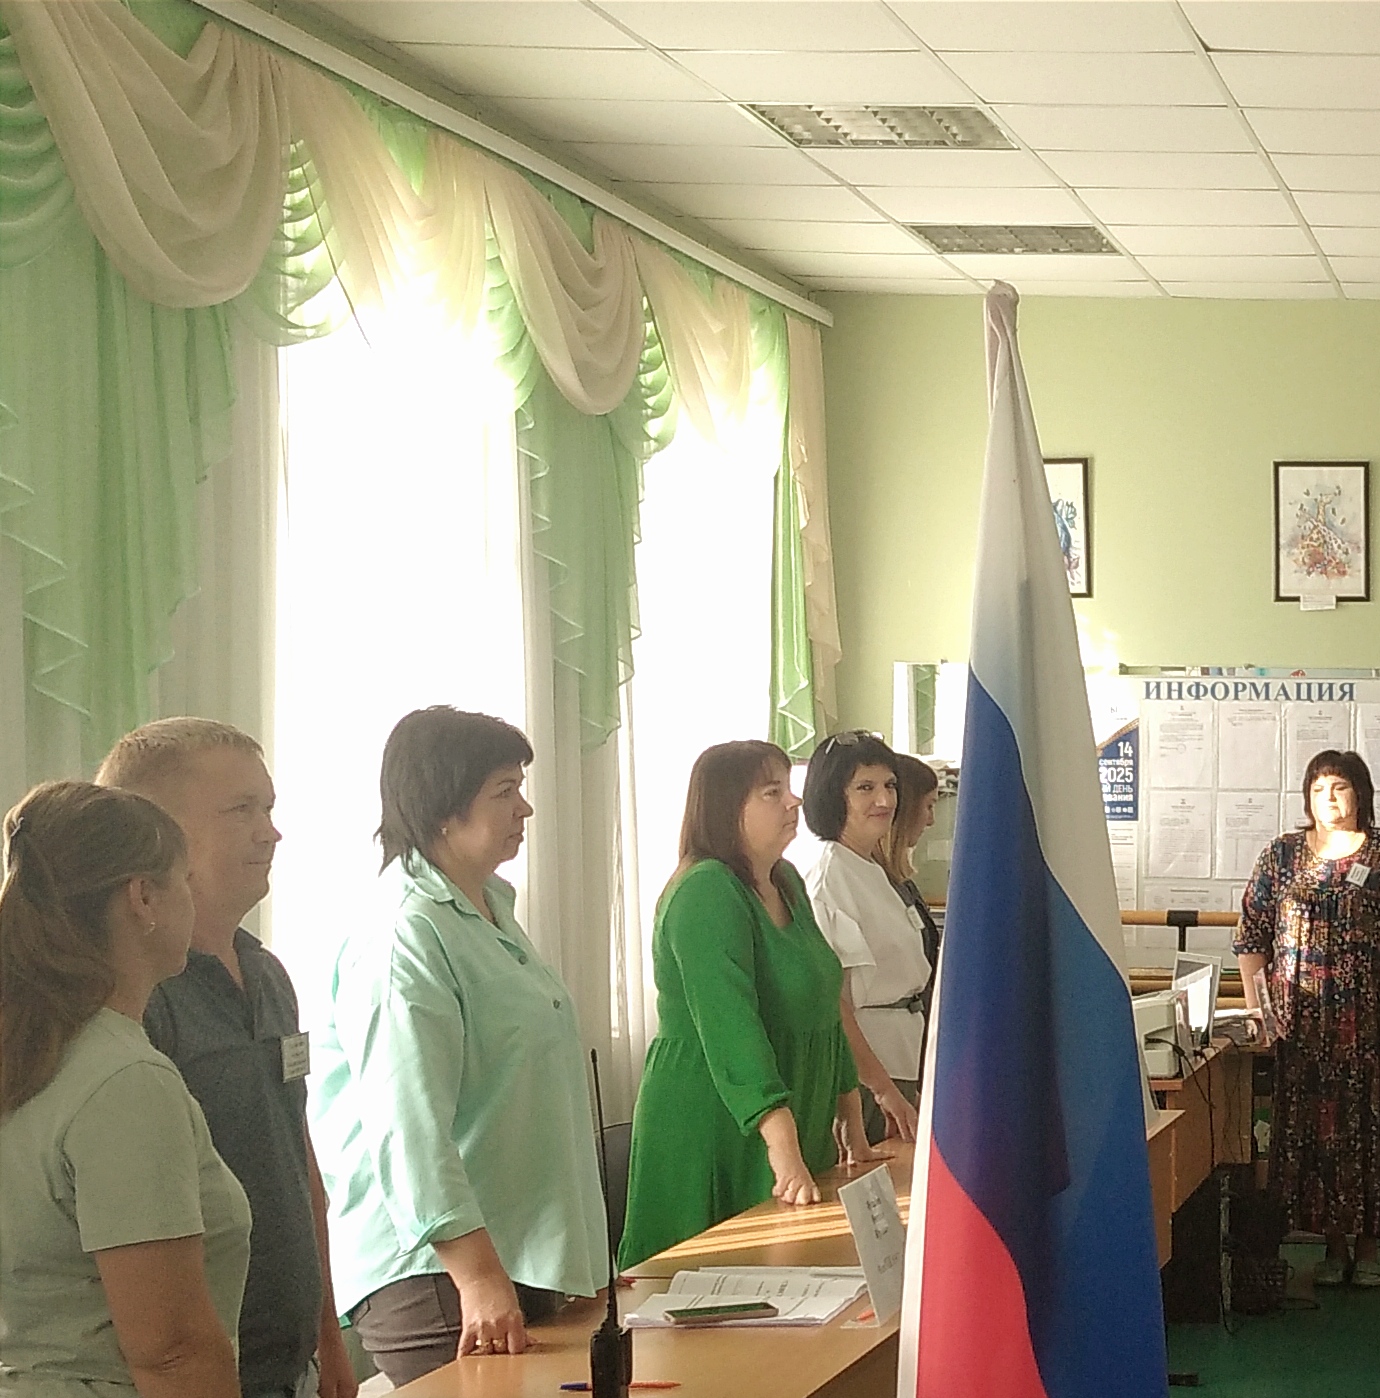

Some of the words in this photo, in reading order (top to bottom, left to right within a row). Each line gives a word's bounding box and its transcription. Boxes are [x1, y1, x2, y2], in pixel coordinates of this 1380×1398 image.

[1144, 681, 1356, 702] ИНФОРМАЦИЯ
[1117, 741, 1133, 757] 14
[1098, 766, 1134, 783] 2025
[1112, 784, 1133, 793] ДЕНЬ
